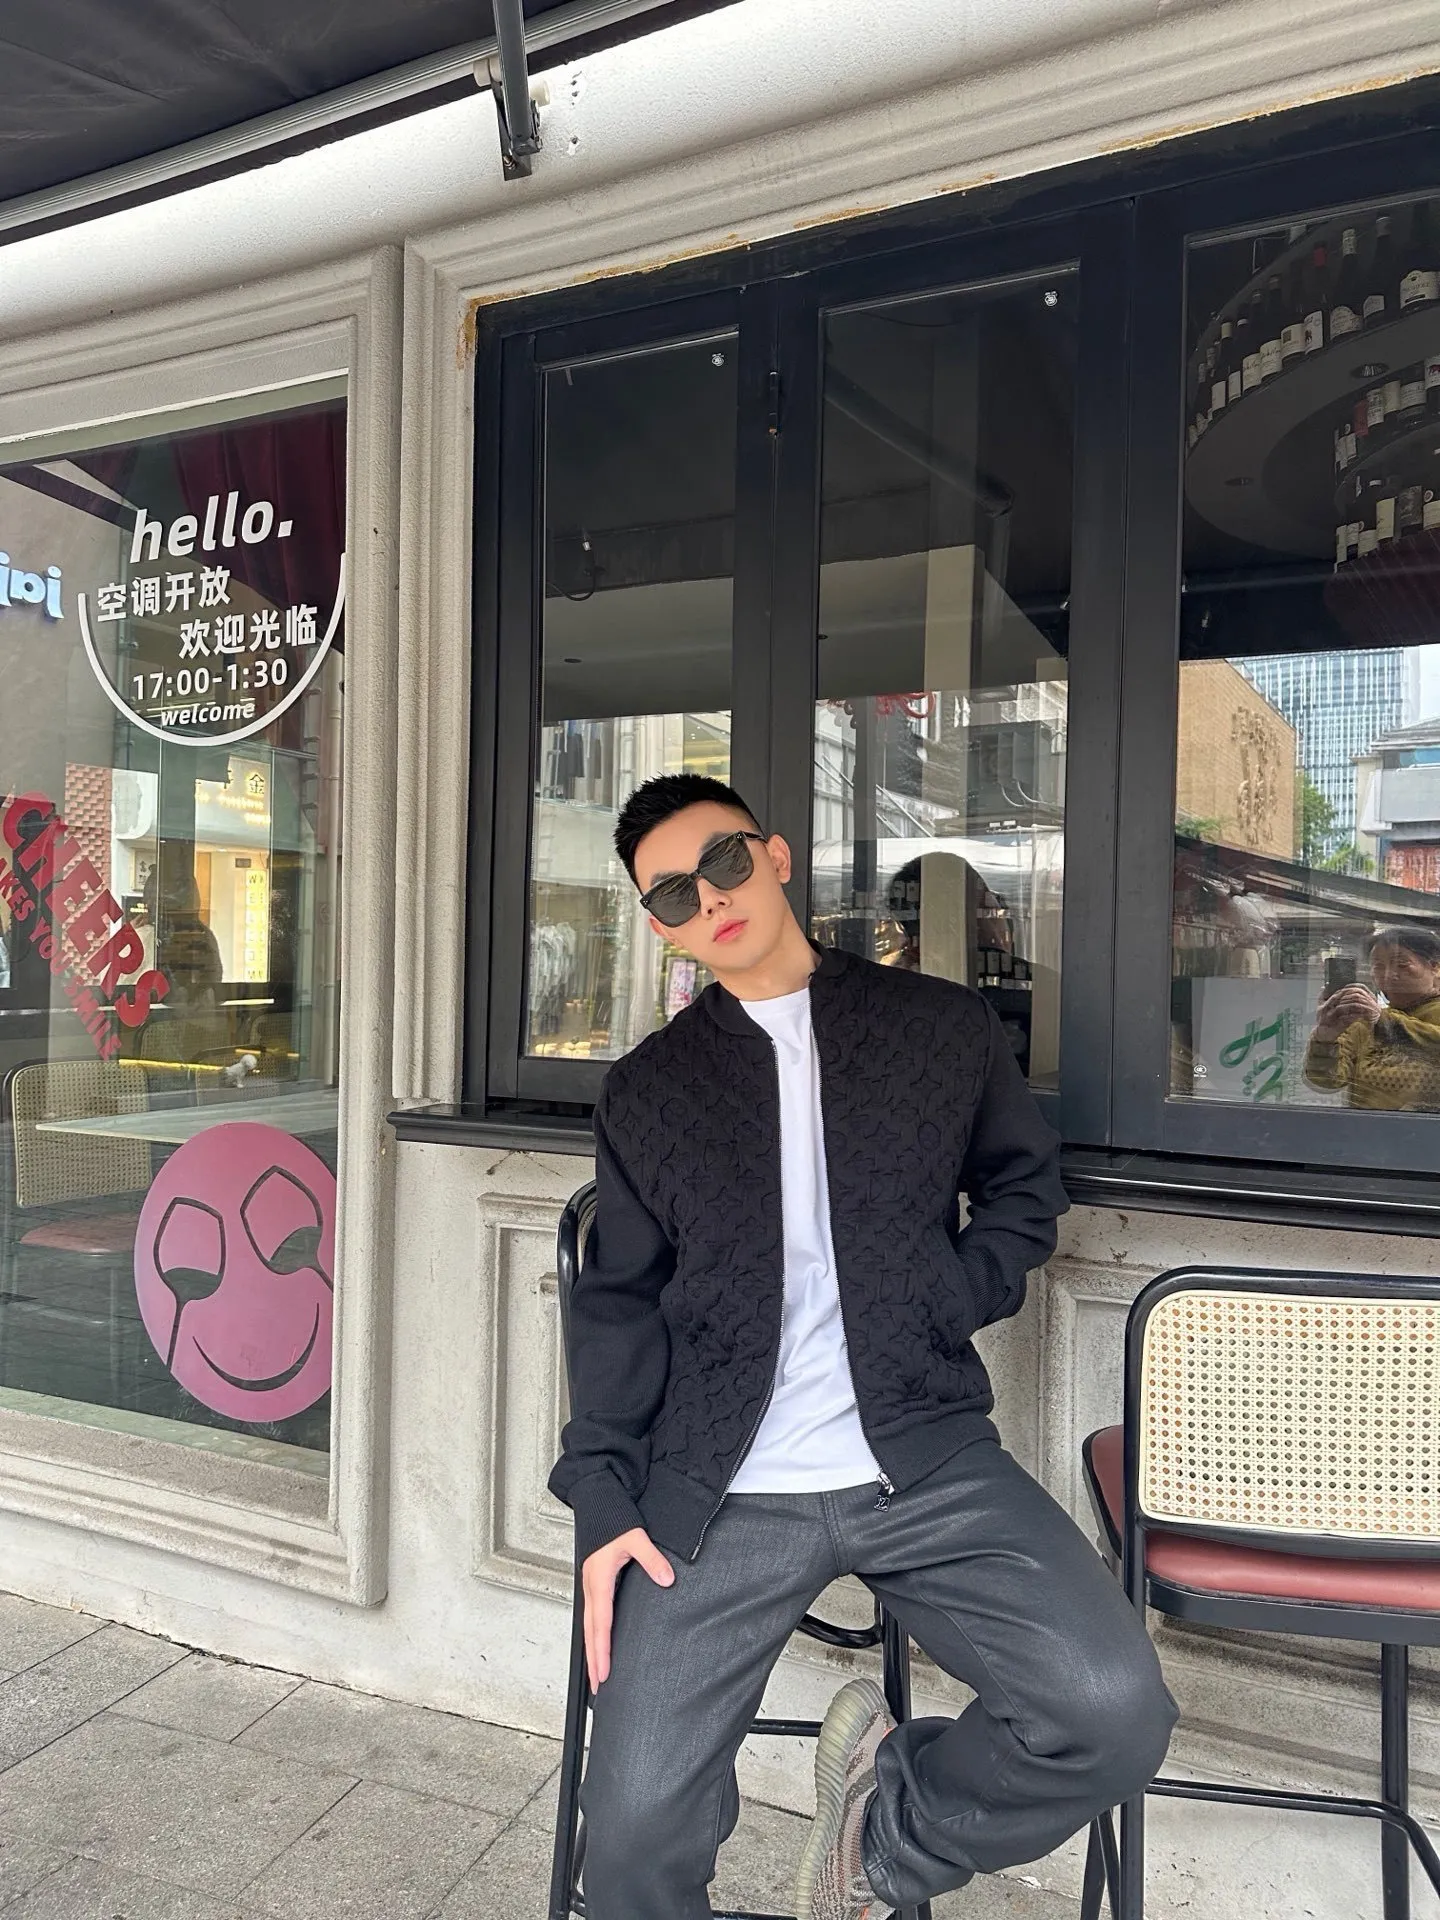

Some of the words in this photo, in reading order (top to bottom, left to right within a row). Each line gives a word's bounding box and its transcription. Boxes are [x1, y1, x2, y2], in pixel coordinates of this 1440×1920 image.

[130, 490, 293, 564] hello.
[97, 565, 231, 622] 空调开放
[178, 604, 318, 659] 欢迎光临
[133, 658, 288, 700] 17:00-1:30
[161, 702, 256, 726] welcome
[3, 791, 171, 1028] CHEERS
[28, 916, 72, 977] YOU
[63, 974, 123, 1062] SMILE
